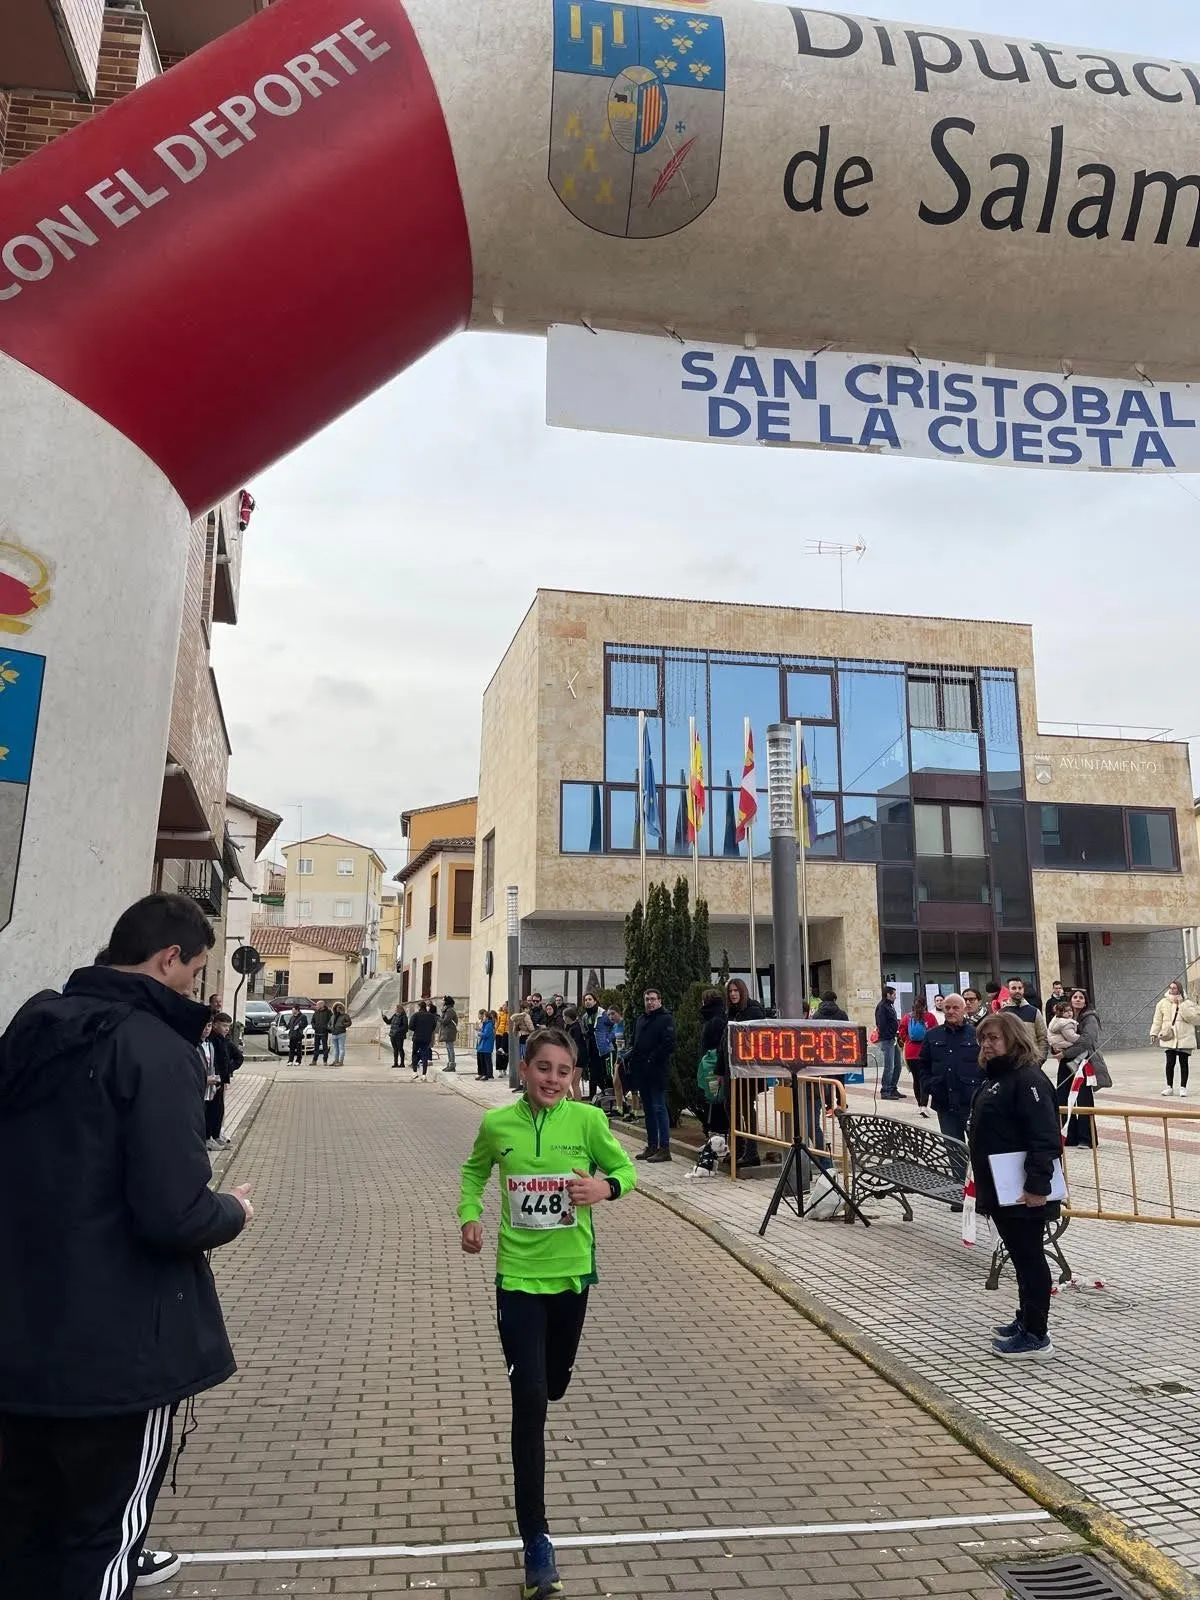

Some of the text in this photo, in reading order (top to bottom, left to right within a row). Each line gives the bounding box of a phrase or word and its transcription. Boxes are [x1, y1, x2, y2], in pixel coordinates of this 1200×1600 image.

[86, 168, 169, 229] EL
[153, 17, 392, 185] DEPORTE
[783, 117, 1200, 247] de Salam
[681, 351, 1195, 428] SAN CRISTOBAL
[708, 397, 1176, 468] DE LA CUESTA
[1060, 758, 1157, 773] AYUNTAMIENTO
[521, 1194, 562, 1215] 448
